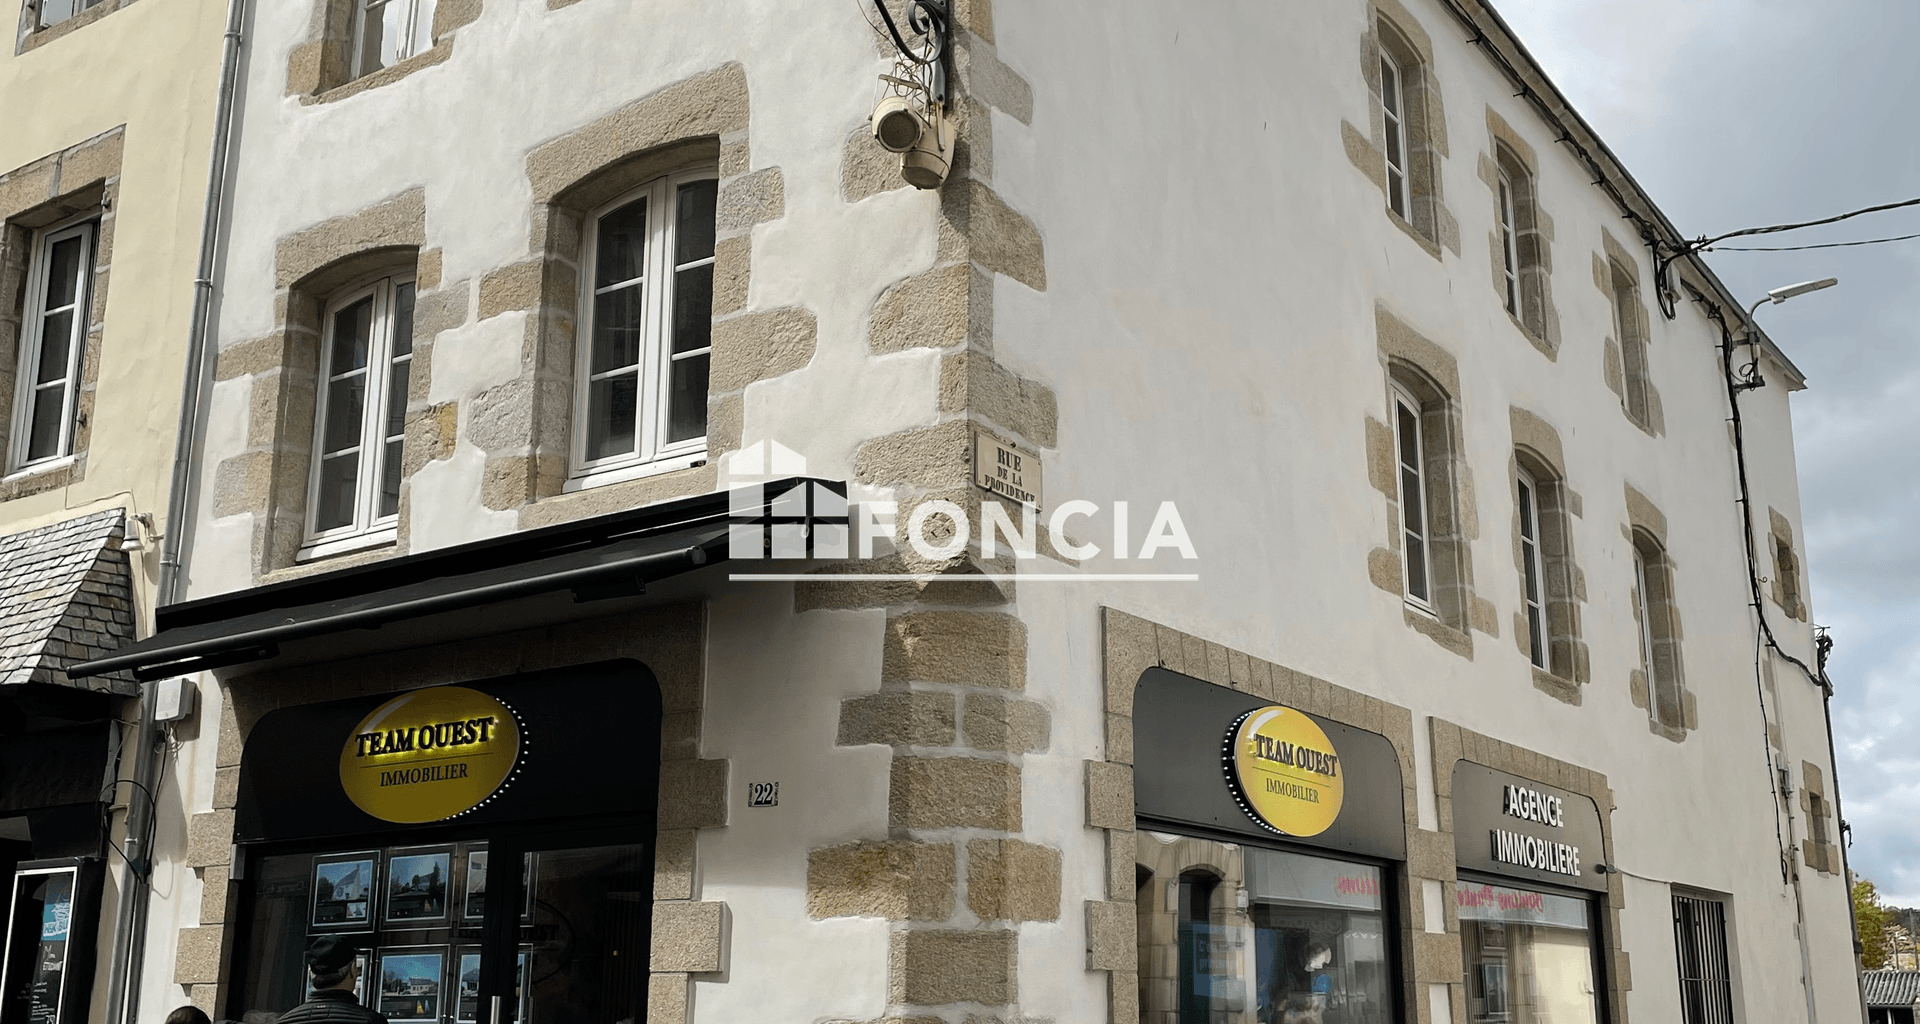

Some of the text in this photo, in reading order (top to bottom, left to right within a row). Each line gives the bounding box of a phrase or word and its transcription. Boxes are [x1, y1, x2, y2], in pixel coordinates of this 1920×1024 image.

[997, 447, 1021, 472] RUE
[984, 474, 1036, 502] PROVIDENCE
[997, 466, 1023, 487] DE LA
[355, 716, 495, 757] TEAM OUEST
[1254, 733, 1337, 777] TEAM OUEST
[379, 763, 468, 787] IMMOBILIER
[754, 782, 773, 806] 22
[1266, 777, 1320, 804] IMMOBILIER
[1508, 784, 1564, 828] AGENCE
[1496, 828, 1581, 877] IMMOBILIERE
